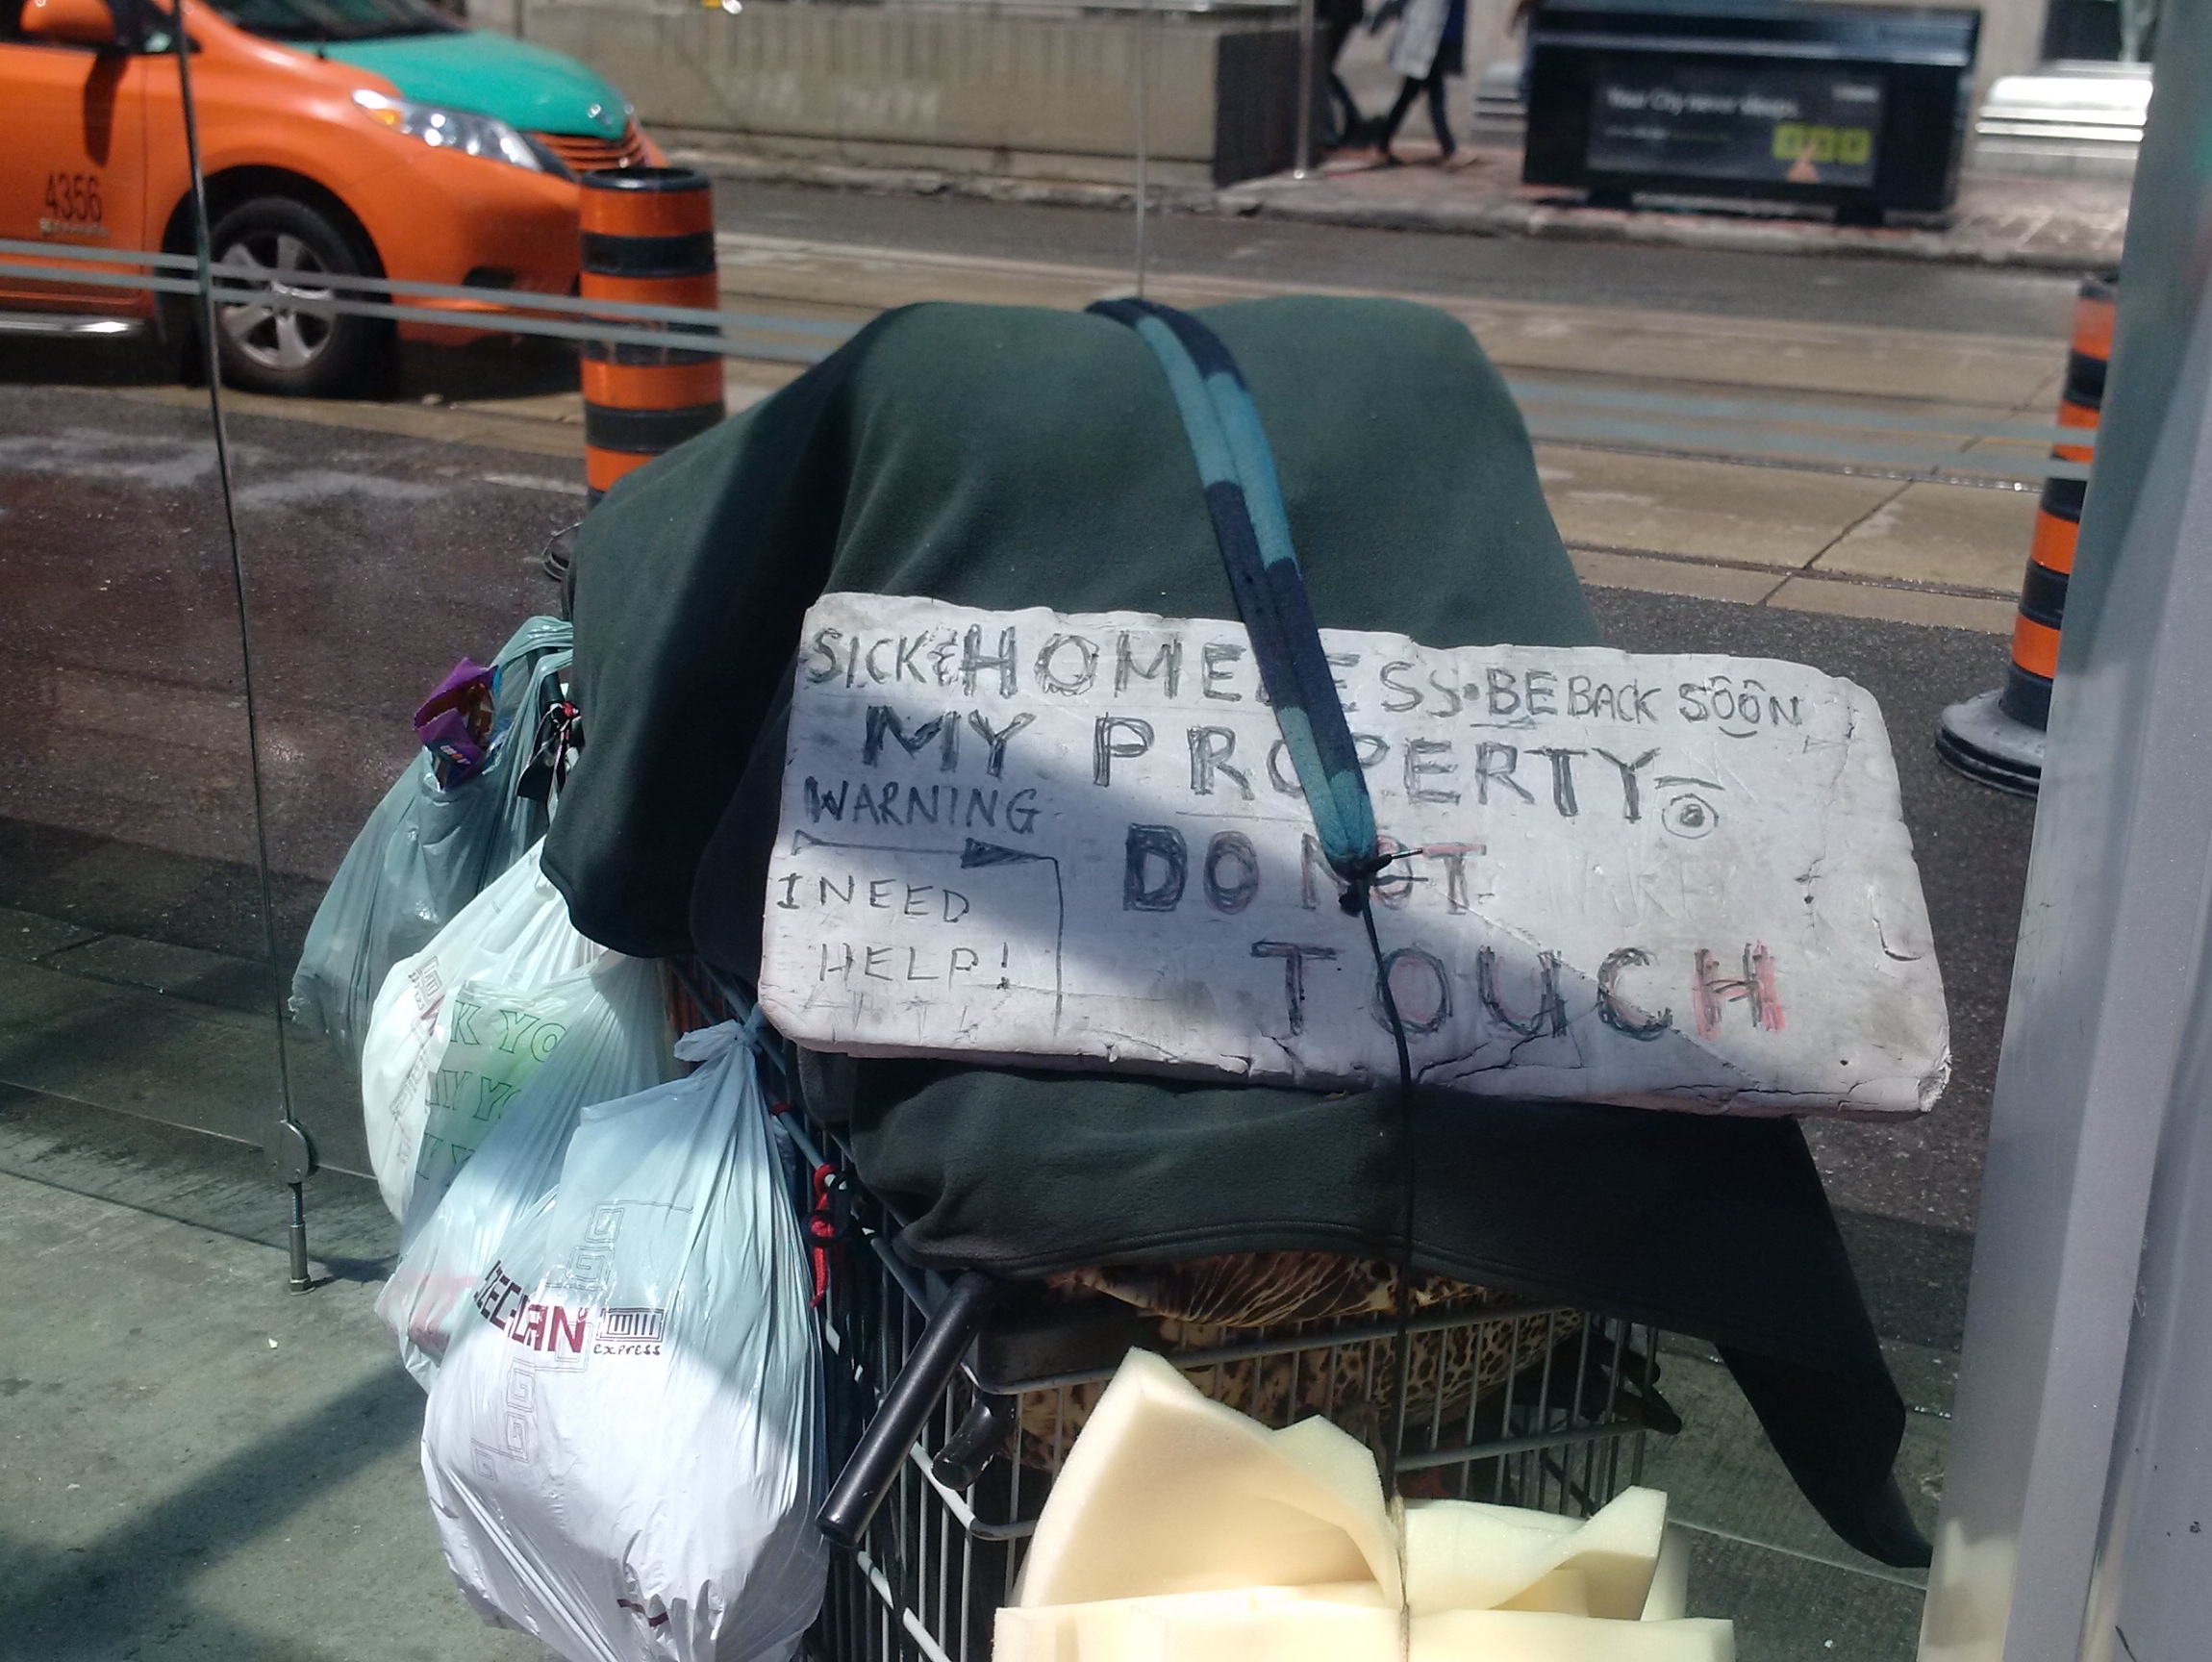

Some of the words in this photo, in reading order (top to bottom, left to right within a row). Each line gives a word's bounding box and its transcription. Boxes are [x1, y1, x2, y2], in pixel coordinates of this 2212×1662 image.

[45, 173, 103, 221] 4356
[961, 623, 1464, 718] HOMEESS
[1678, 675, 1803, 727] SOON
[864, 705, 1036, 778] MY
[804, 775, 1043, 835] WARNING
[777, 871, 800, 910] I
[818, 875, 969, 923] NEED
[818, 942, 1010, 991] HELP!
[1251, 940, 1787, 1041] TOUCH
[592, 1343, 662, 1357] express
